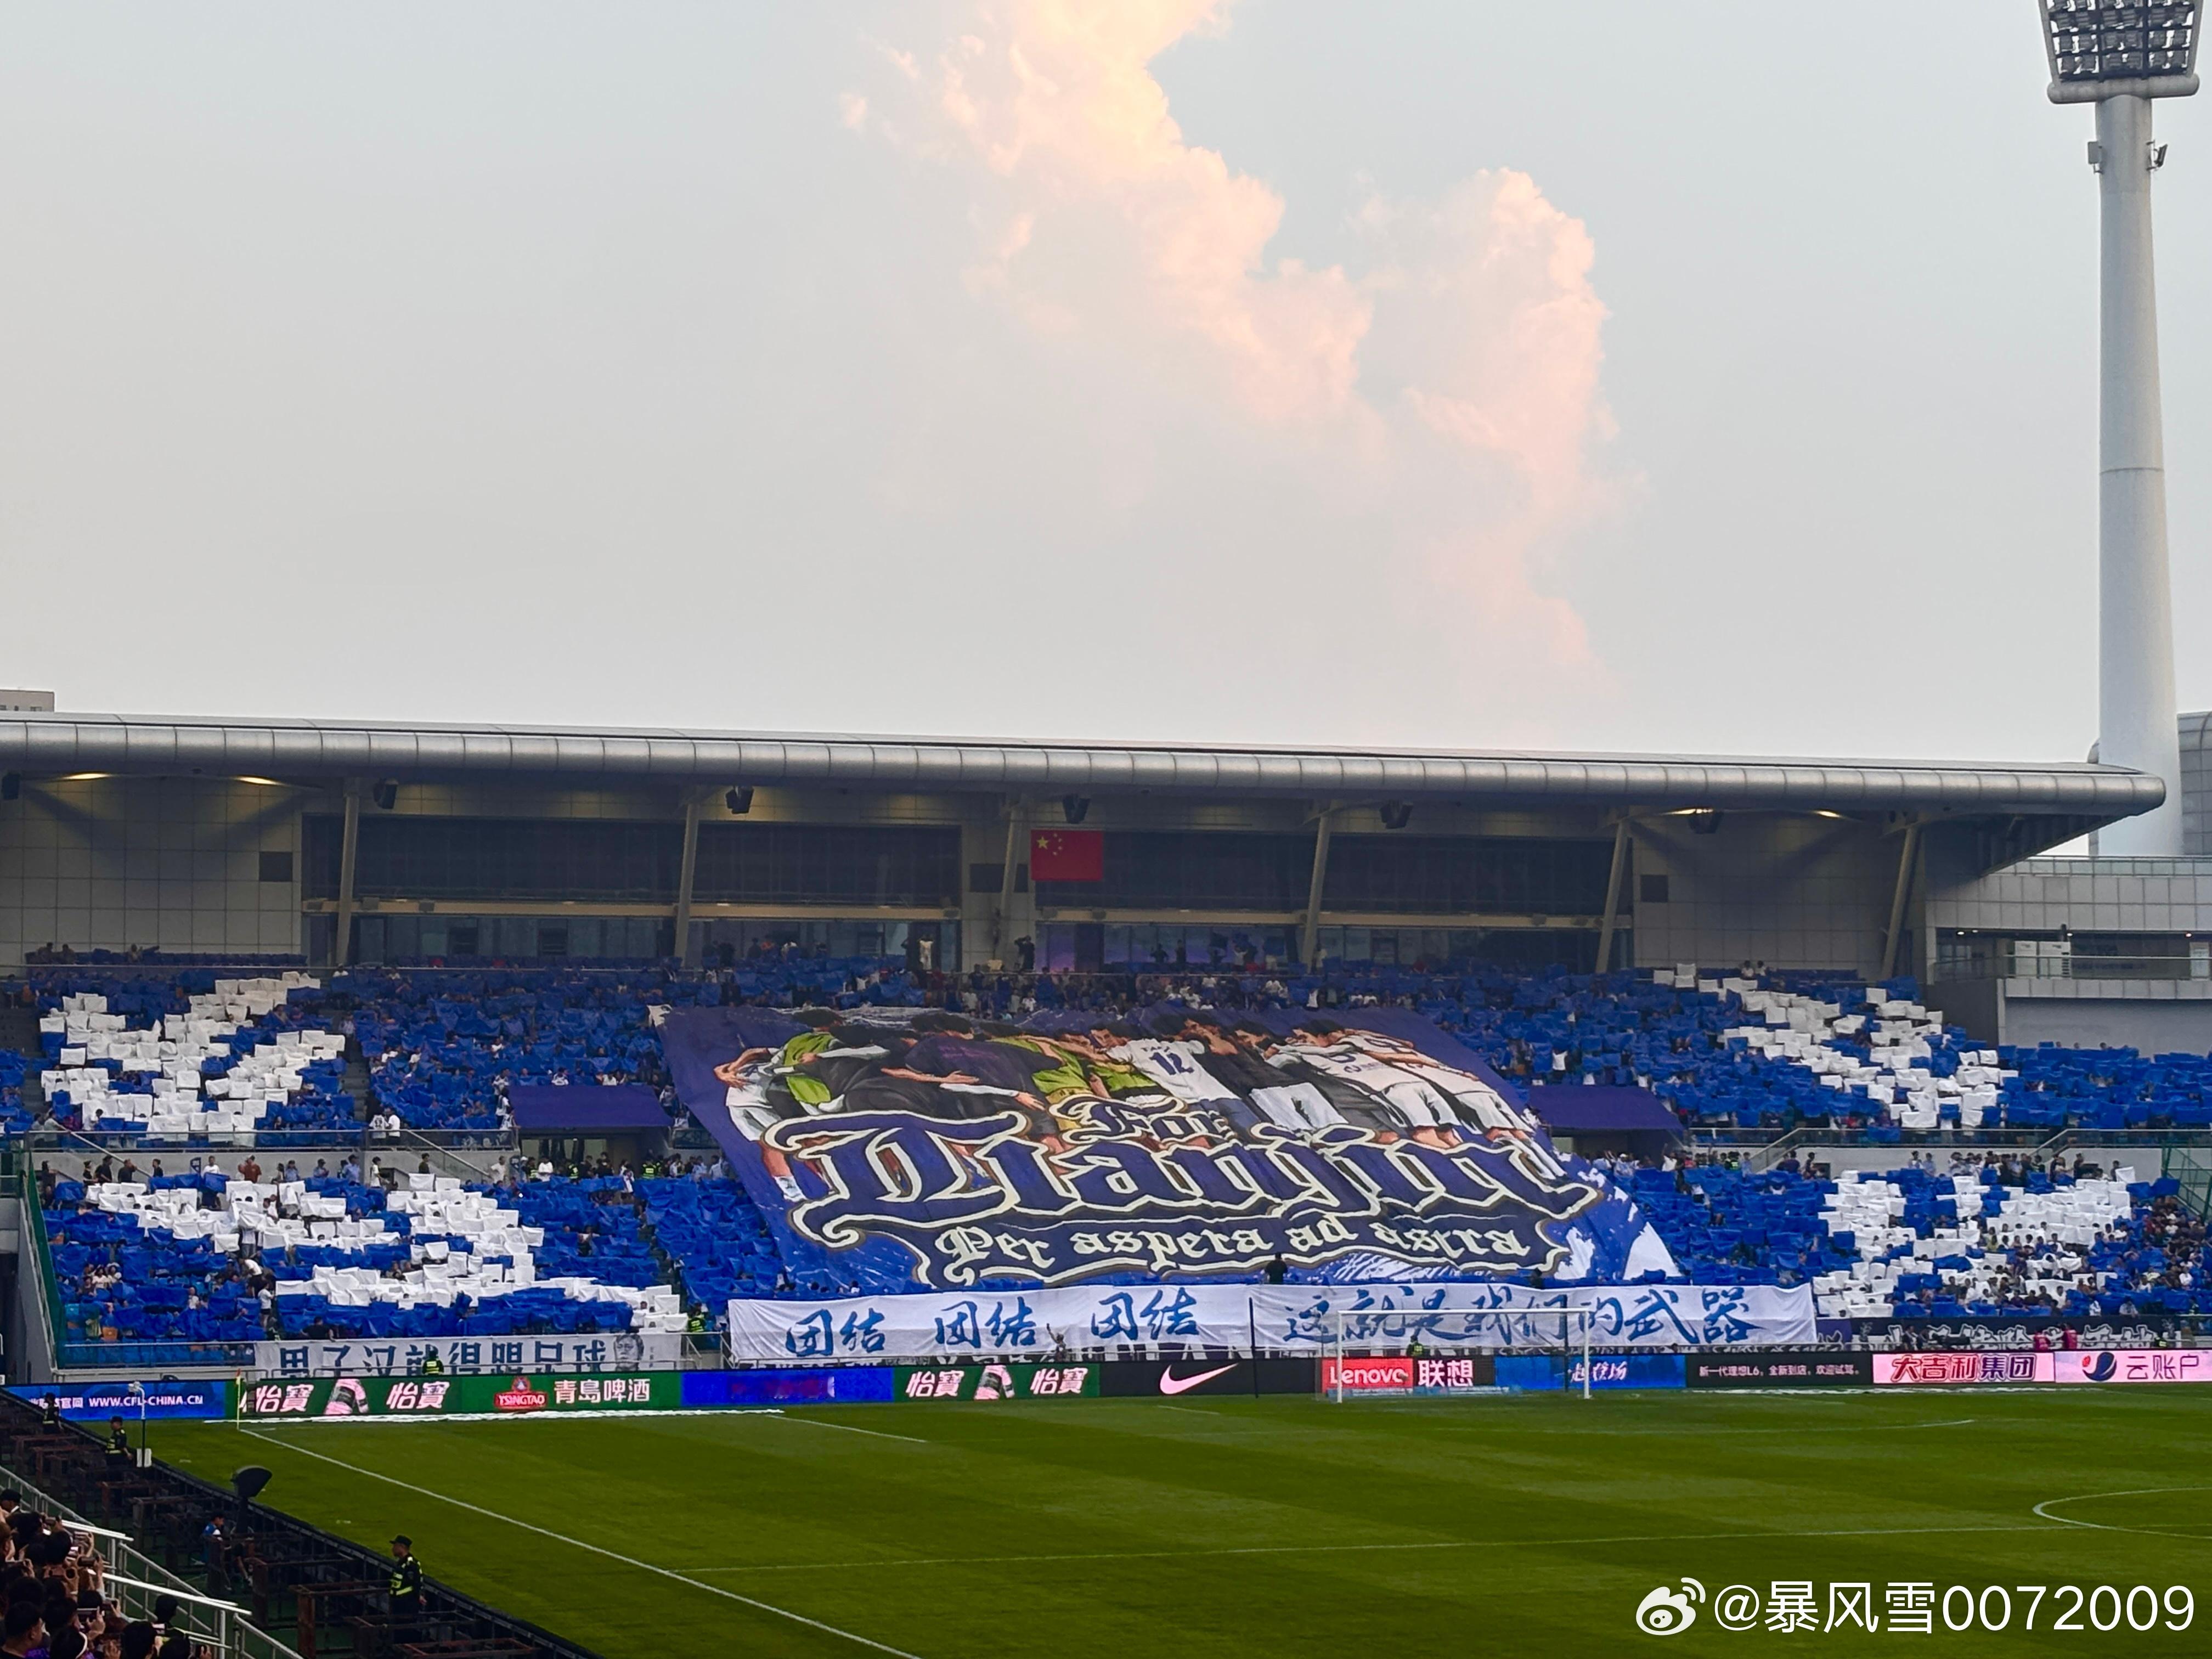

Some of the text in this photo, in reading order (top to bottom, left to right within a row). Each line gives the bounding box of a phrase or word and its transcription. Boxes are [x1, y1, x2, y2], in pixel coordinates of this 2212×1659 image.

[1149, 1052, 1194, 1076] 12
[1048, 1093, 1234, 1144] For
[934, 1214, 1531, 1272] Per aspera ad astra
[785, 1307, 885, 1357] 团结
[935, 1296, 1036, 1348] 团结
[1091, 1286, 1200, 1340] 团结
[1282, 1284, 1762, 1345] 这就是我们的武器
[1418, 1359, 1474, 1387] 联想
[1892, 1354, 2036, 1381] 大吉利集团
[2126, 1353, 2199, 1380] 云账户
[554, 1378, 650, 1404] 青島啤酒
[905, 1369, 964, 1397] 怡寶
[1030, 1367, 1088, 1394] 怡寶
[386, 1381, 450, 1410] 怡寶
[498, 1394, 546, 1406] TSINGTAO
